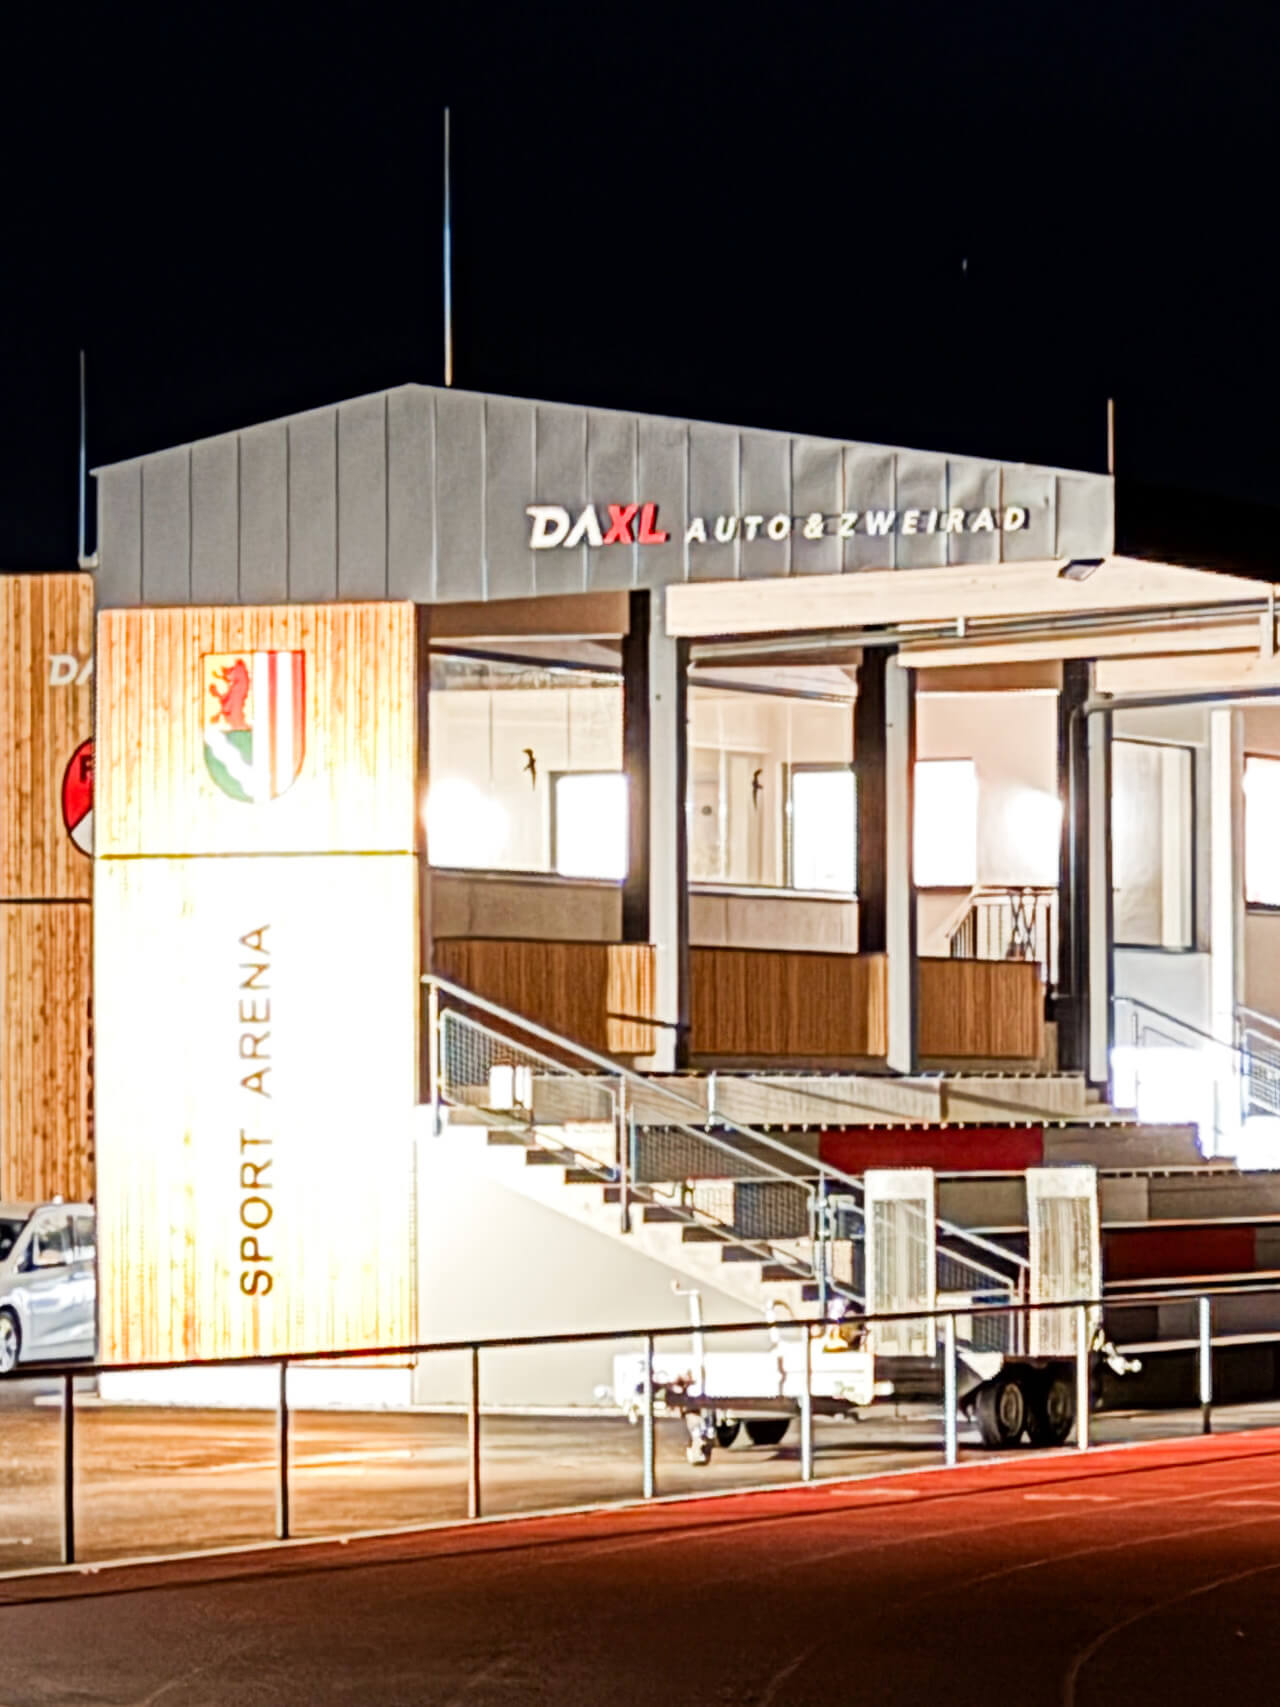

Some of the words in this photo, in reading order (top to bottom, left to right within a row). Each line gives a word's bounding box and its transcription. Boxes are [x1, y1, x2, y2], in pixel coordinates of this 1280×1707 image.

[526, 503, 669, 549] DAXL
[684, 513, 791, 545] AUTO
[803, 515, 825, 541] &
[837, 506, 1029, 540] ZWEIRAD
[238, 924, 271, 1098] ARENA
[240, 1129, 273, 1297] SPORT
